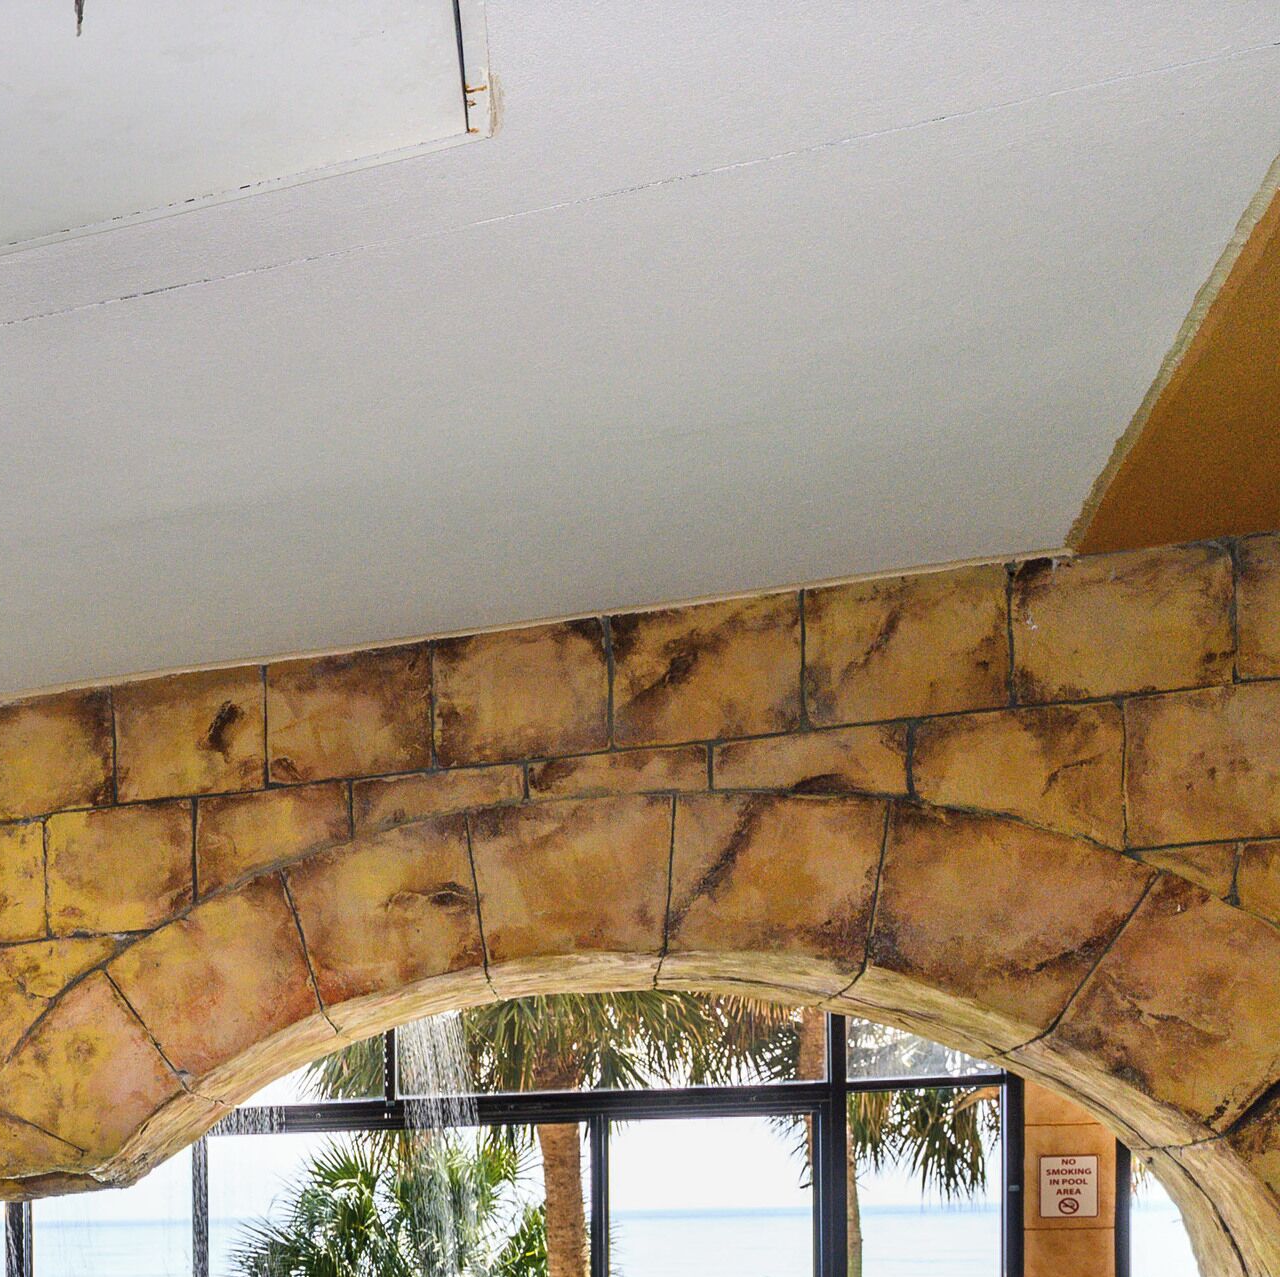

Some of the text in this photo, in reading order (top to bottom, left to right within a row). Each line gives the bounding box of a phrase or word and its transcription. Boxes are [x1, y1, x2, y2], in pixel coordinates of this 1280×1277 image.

[1046, 1167, 1092, 1176] SMOKING
[1061, 1178, 1088, 1186] POOL
[1056, 1188, 1082, 1196] AREA
